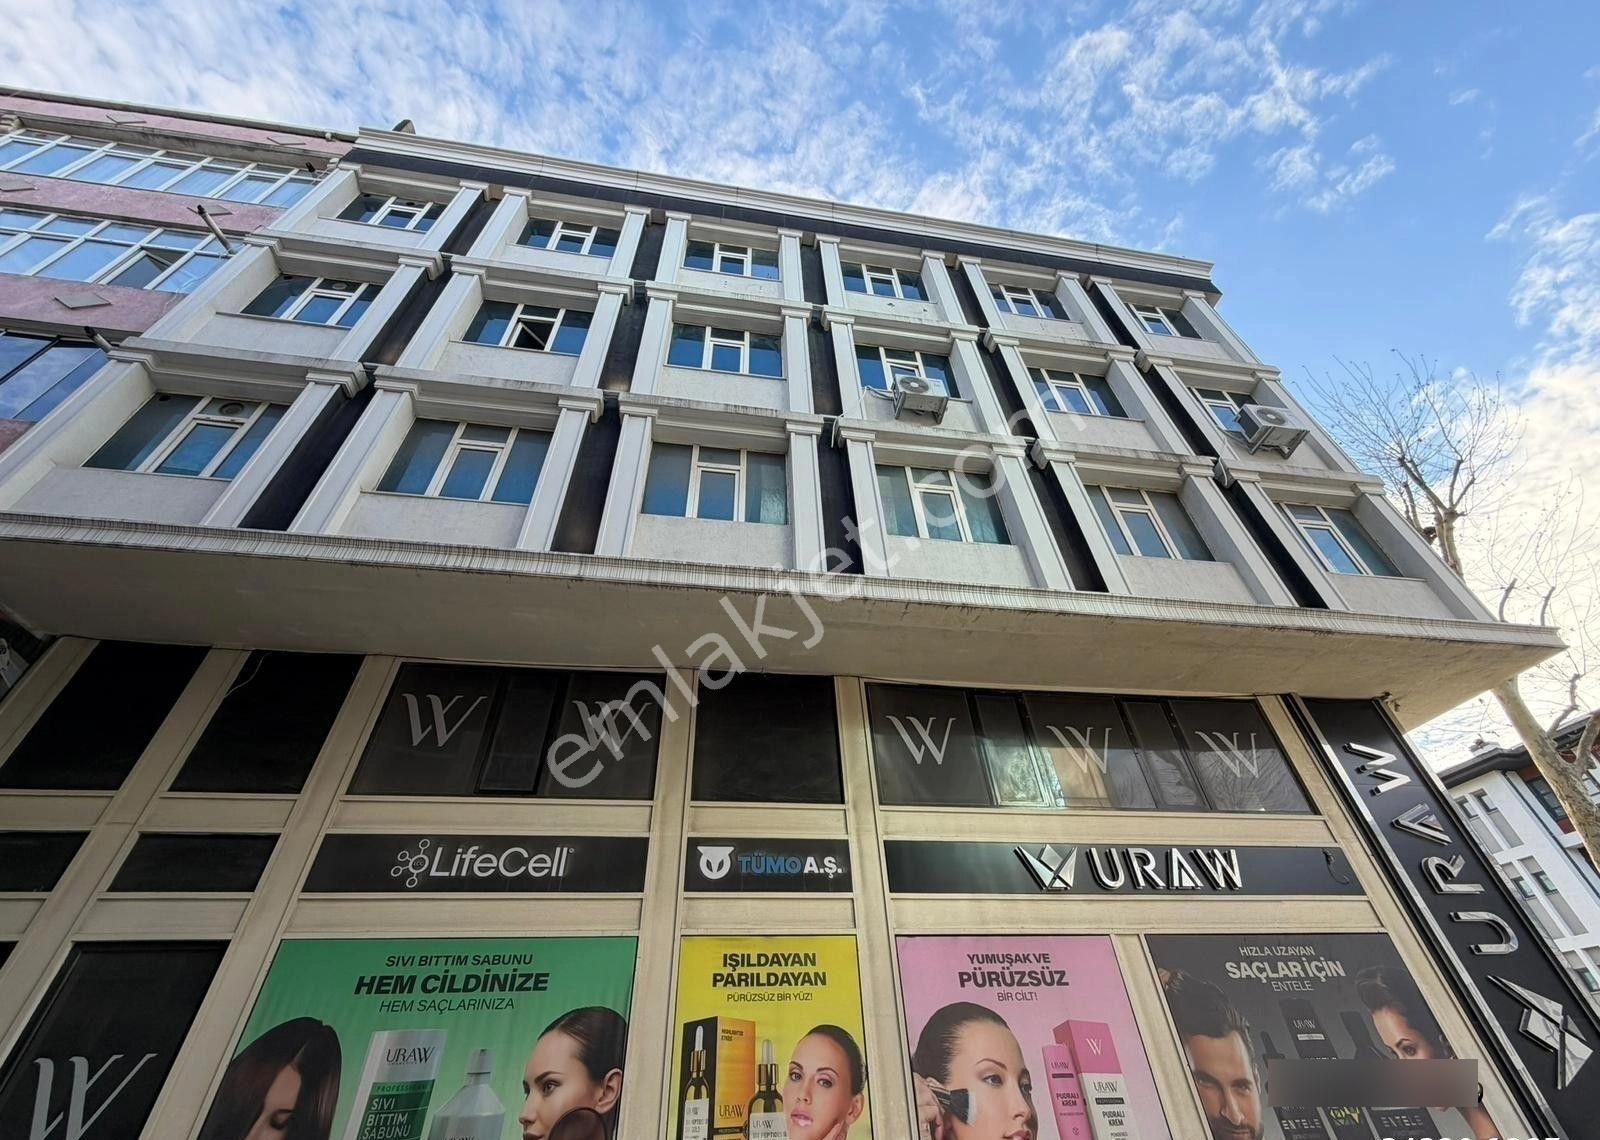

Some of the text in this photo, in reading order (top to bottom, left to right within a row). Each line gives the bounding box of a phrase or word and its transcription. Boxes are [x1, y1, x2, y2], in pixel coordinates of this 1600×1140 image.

[1342, 742, 1519, 955] URAW
[430, 845, 568, 877] LifeCell
[737, 852, 843, 879] TÜMO A.Ş.
[1086, 847, 1243, 890] URAW
[1239, 945, 1316, 956] HIZLA UZAYAN
[385, 954, 533, 967] SIVI BITTIM SABUNU
[723, 953, 817, 972] IŞILDAYAN
[967, 953, 1051, 967] YUMUŞAK VE
[958, 966, 1070, 988] PÜRÜZSÜZ
[1225, 956, 1347, 983] SAÇLAR İÇİN
[354, 968, 550, 995] HEM CİLDİNİZE
[712, 972, 827, 987] PARILDAYAN
[1271, 980, 1314, 991] ENTELE
[727, 991, 813, 1002] PÜRÜZSÜZ BİR YÜZ!
[997, 990, 1038, 1001] BİR CİLT!
[379, 998, 515, 1015] HEM SAÇLARINIZA
[386, 1046, 436, 1063] URAW
[371, 1097, 395, 1110] SIVI
[719, 1104, 746, 1117] URAW
[366, 1112, 409, 1127] BITTIM
[362, 1124, 411, 1140] SABUNU
